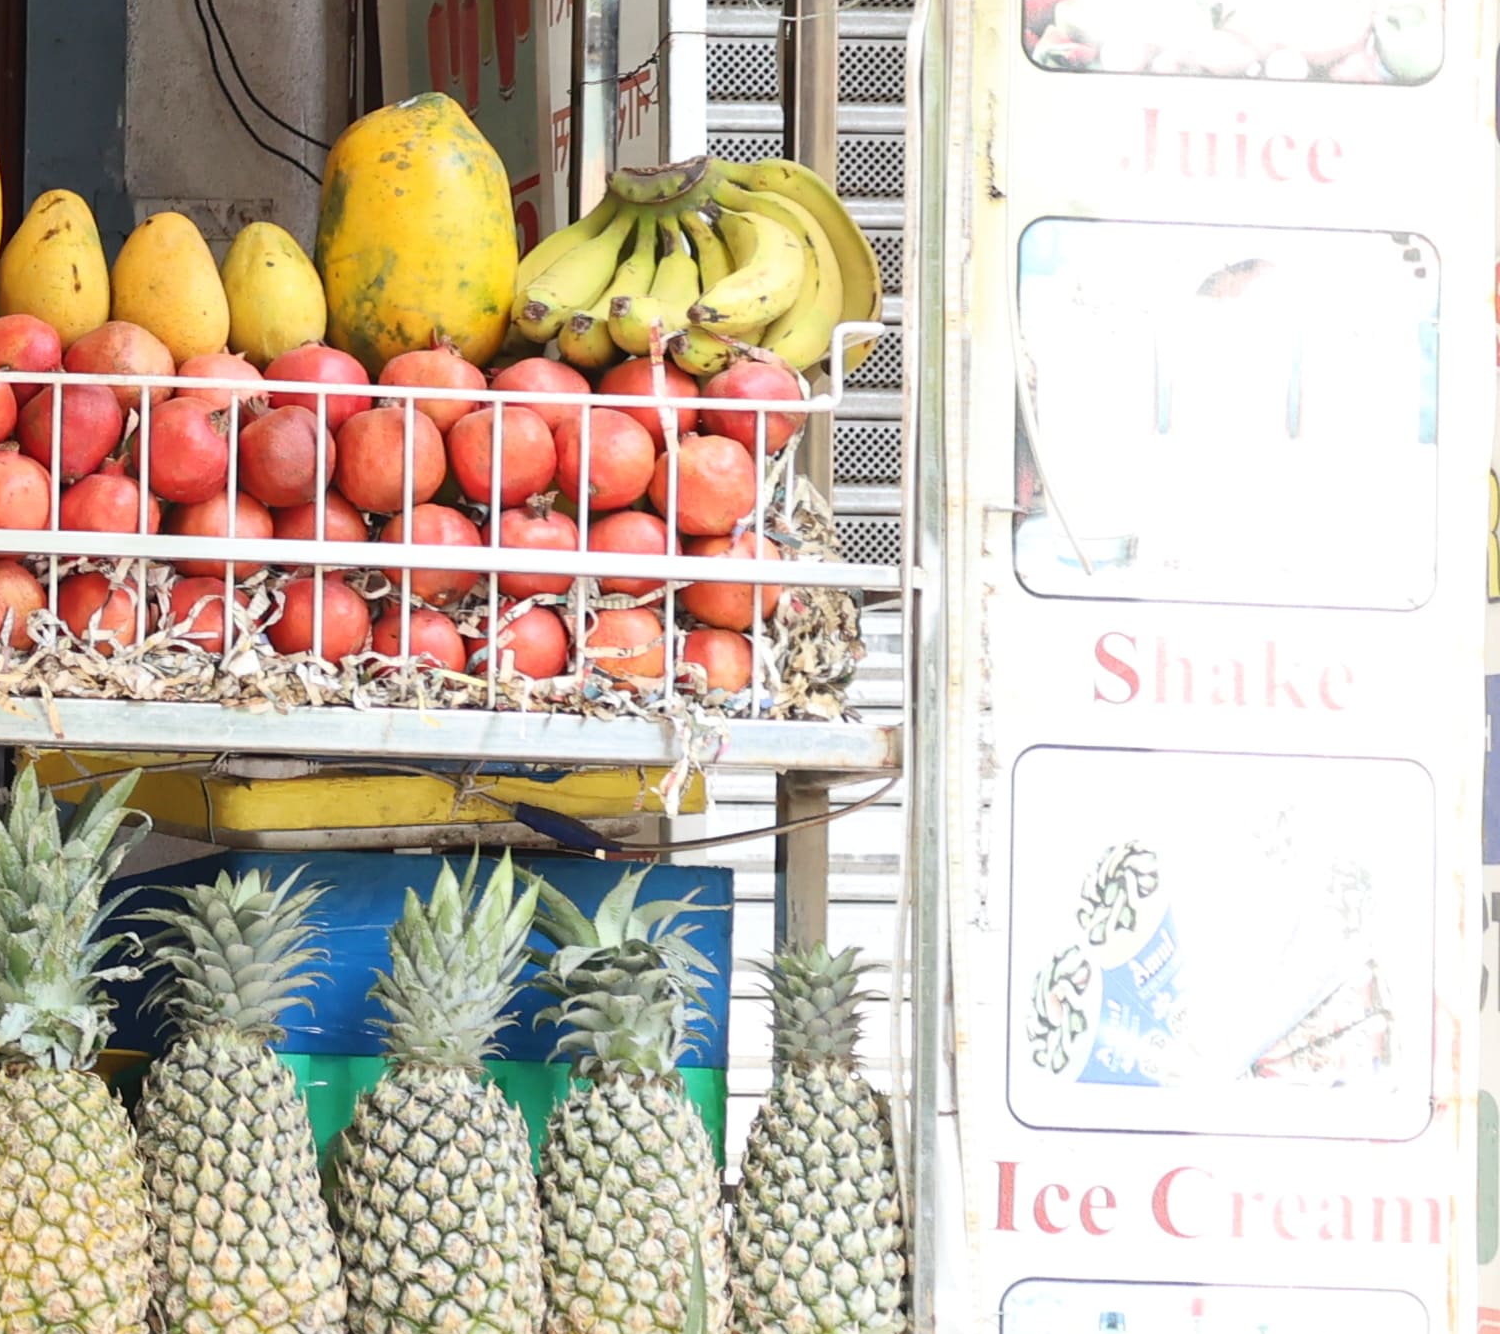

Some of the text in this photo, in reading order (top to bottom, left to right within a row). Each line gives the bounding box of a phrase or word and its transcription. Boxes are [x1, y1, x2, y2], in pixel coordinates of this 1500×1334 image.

[1119, 107, 1344, 185] Juice
[1093, 631, 1355, 711] Shake
[990, 1160, 1442, 1246] Ice Cream
